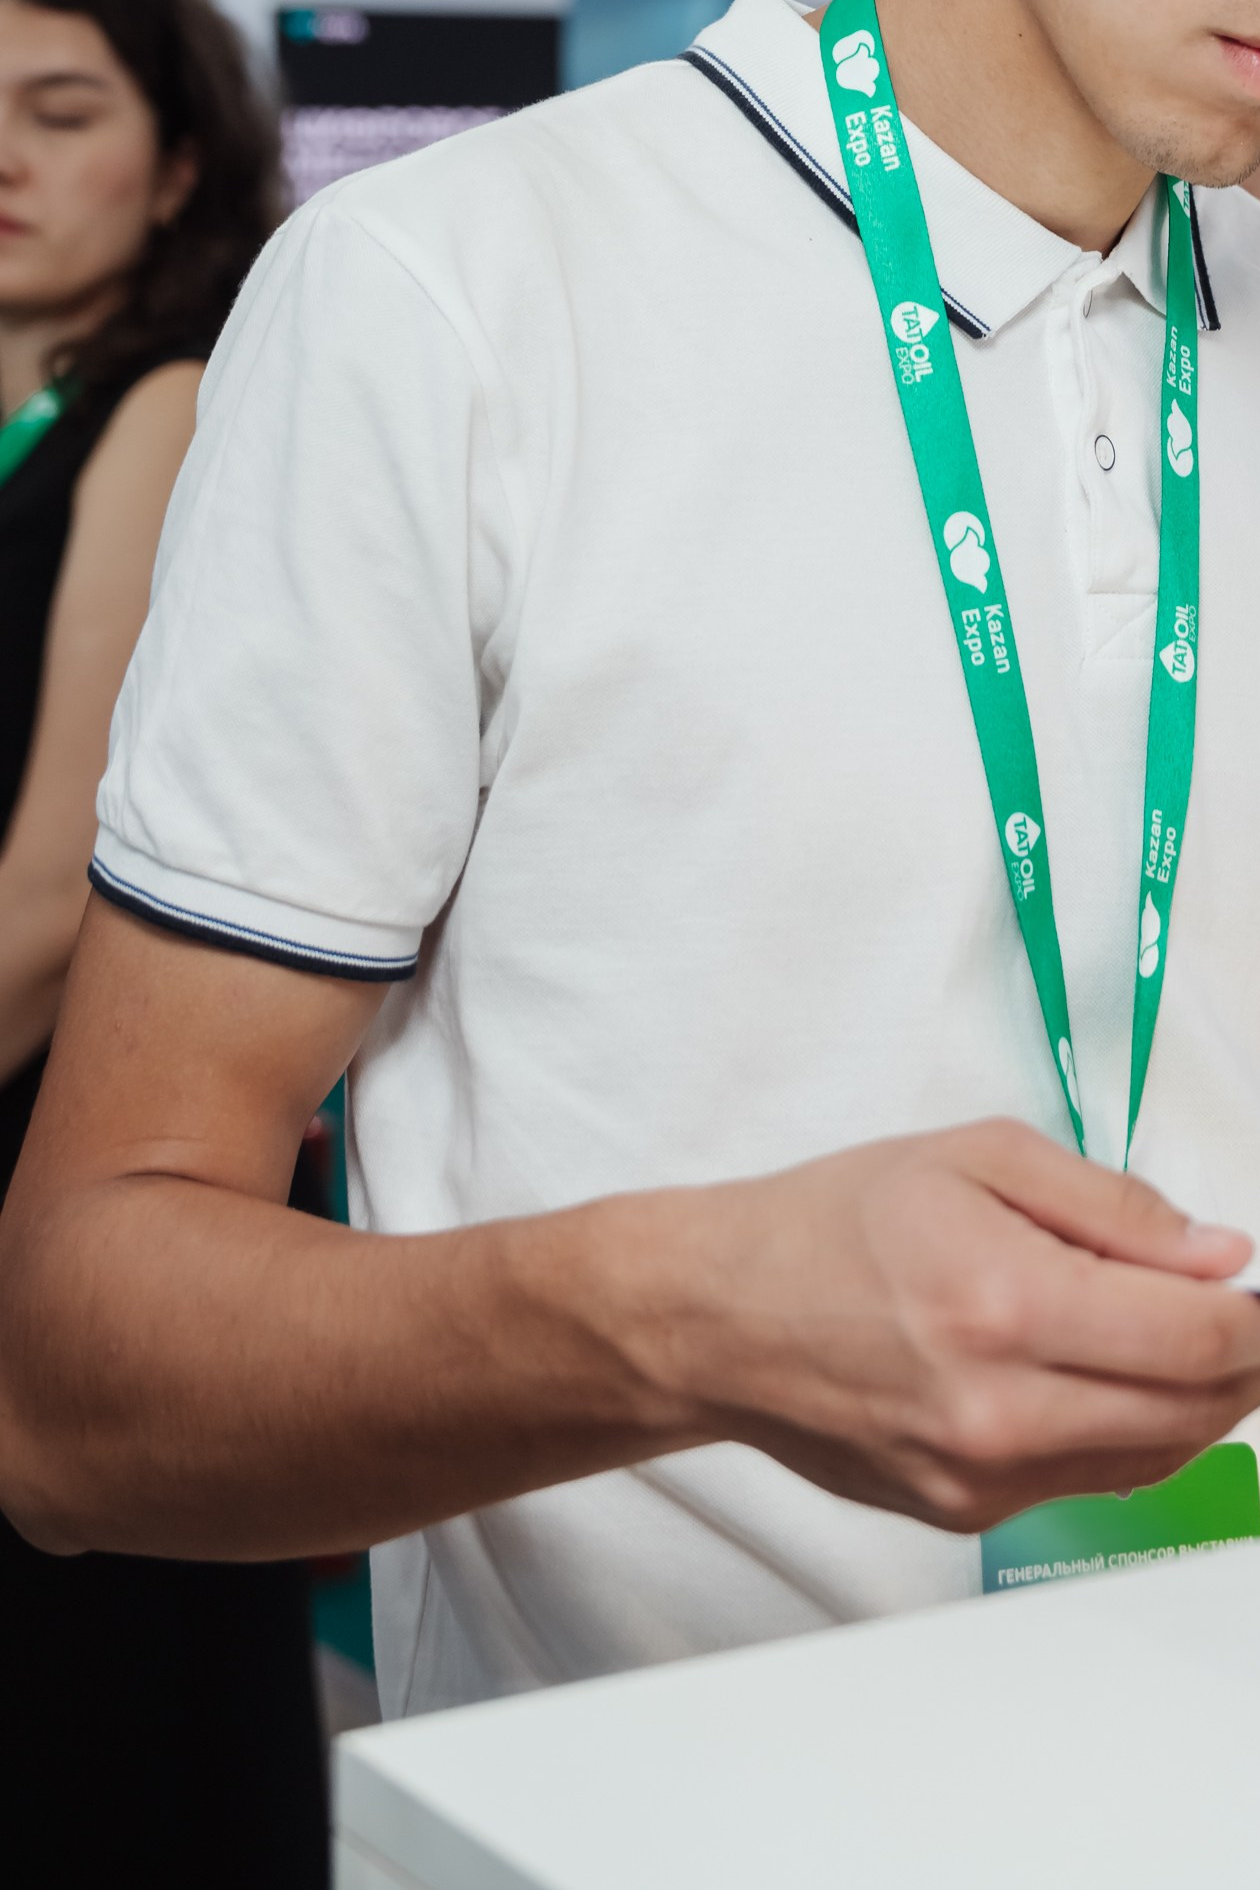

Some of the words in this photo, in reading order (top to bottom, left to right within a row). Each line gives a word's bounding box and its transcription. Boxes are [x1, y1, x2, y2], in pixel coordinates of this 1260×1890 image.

[845, 111, 871, 167] Expo
[870, 105, 900, 172] Kazan
[896, 347, 914, 385] EXPO
[1166, 326, 1178, 388] Kazan
[1179, 345, 1194, 396] Expo
[961, 608, 985, 666] Expo
[984, 604, 1010, 674] Kazan
[1189, 605, 1197, 643] EXPO
[1145, 809, 1163, 879] Kazan
[1156, 827, 1177, 884] Expo
[1011, 862, 1024, 901] EXPO
[998, 1552, 1104, 1585] ГЕНЕРАЛЬНЫЙ
[1108, 1546, 1175, 1568] СПОНСОР
